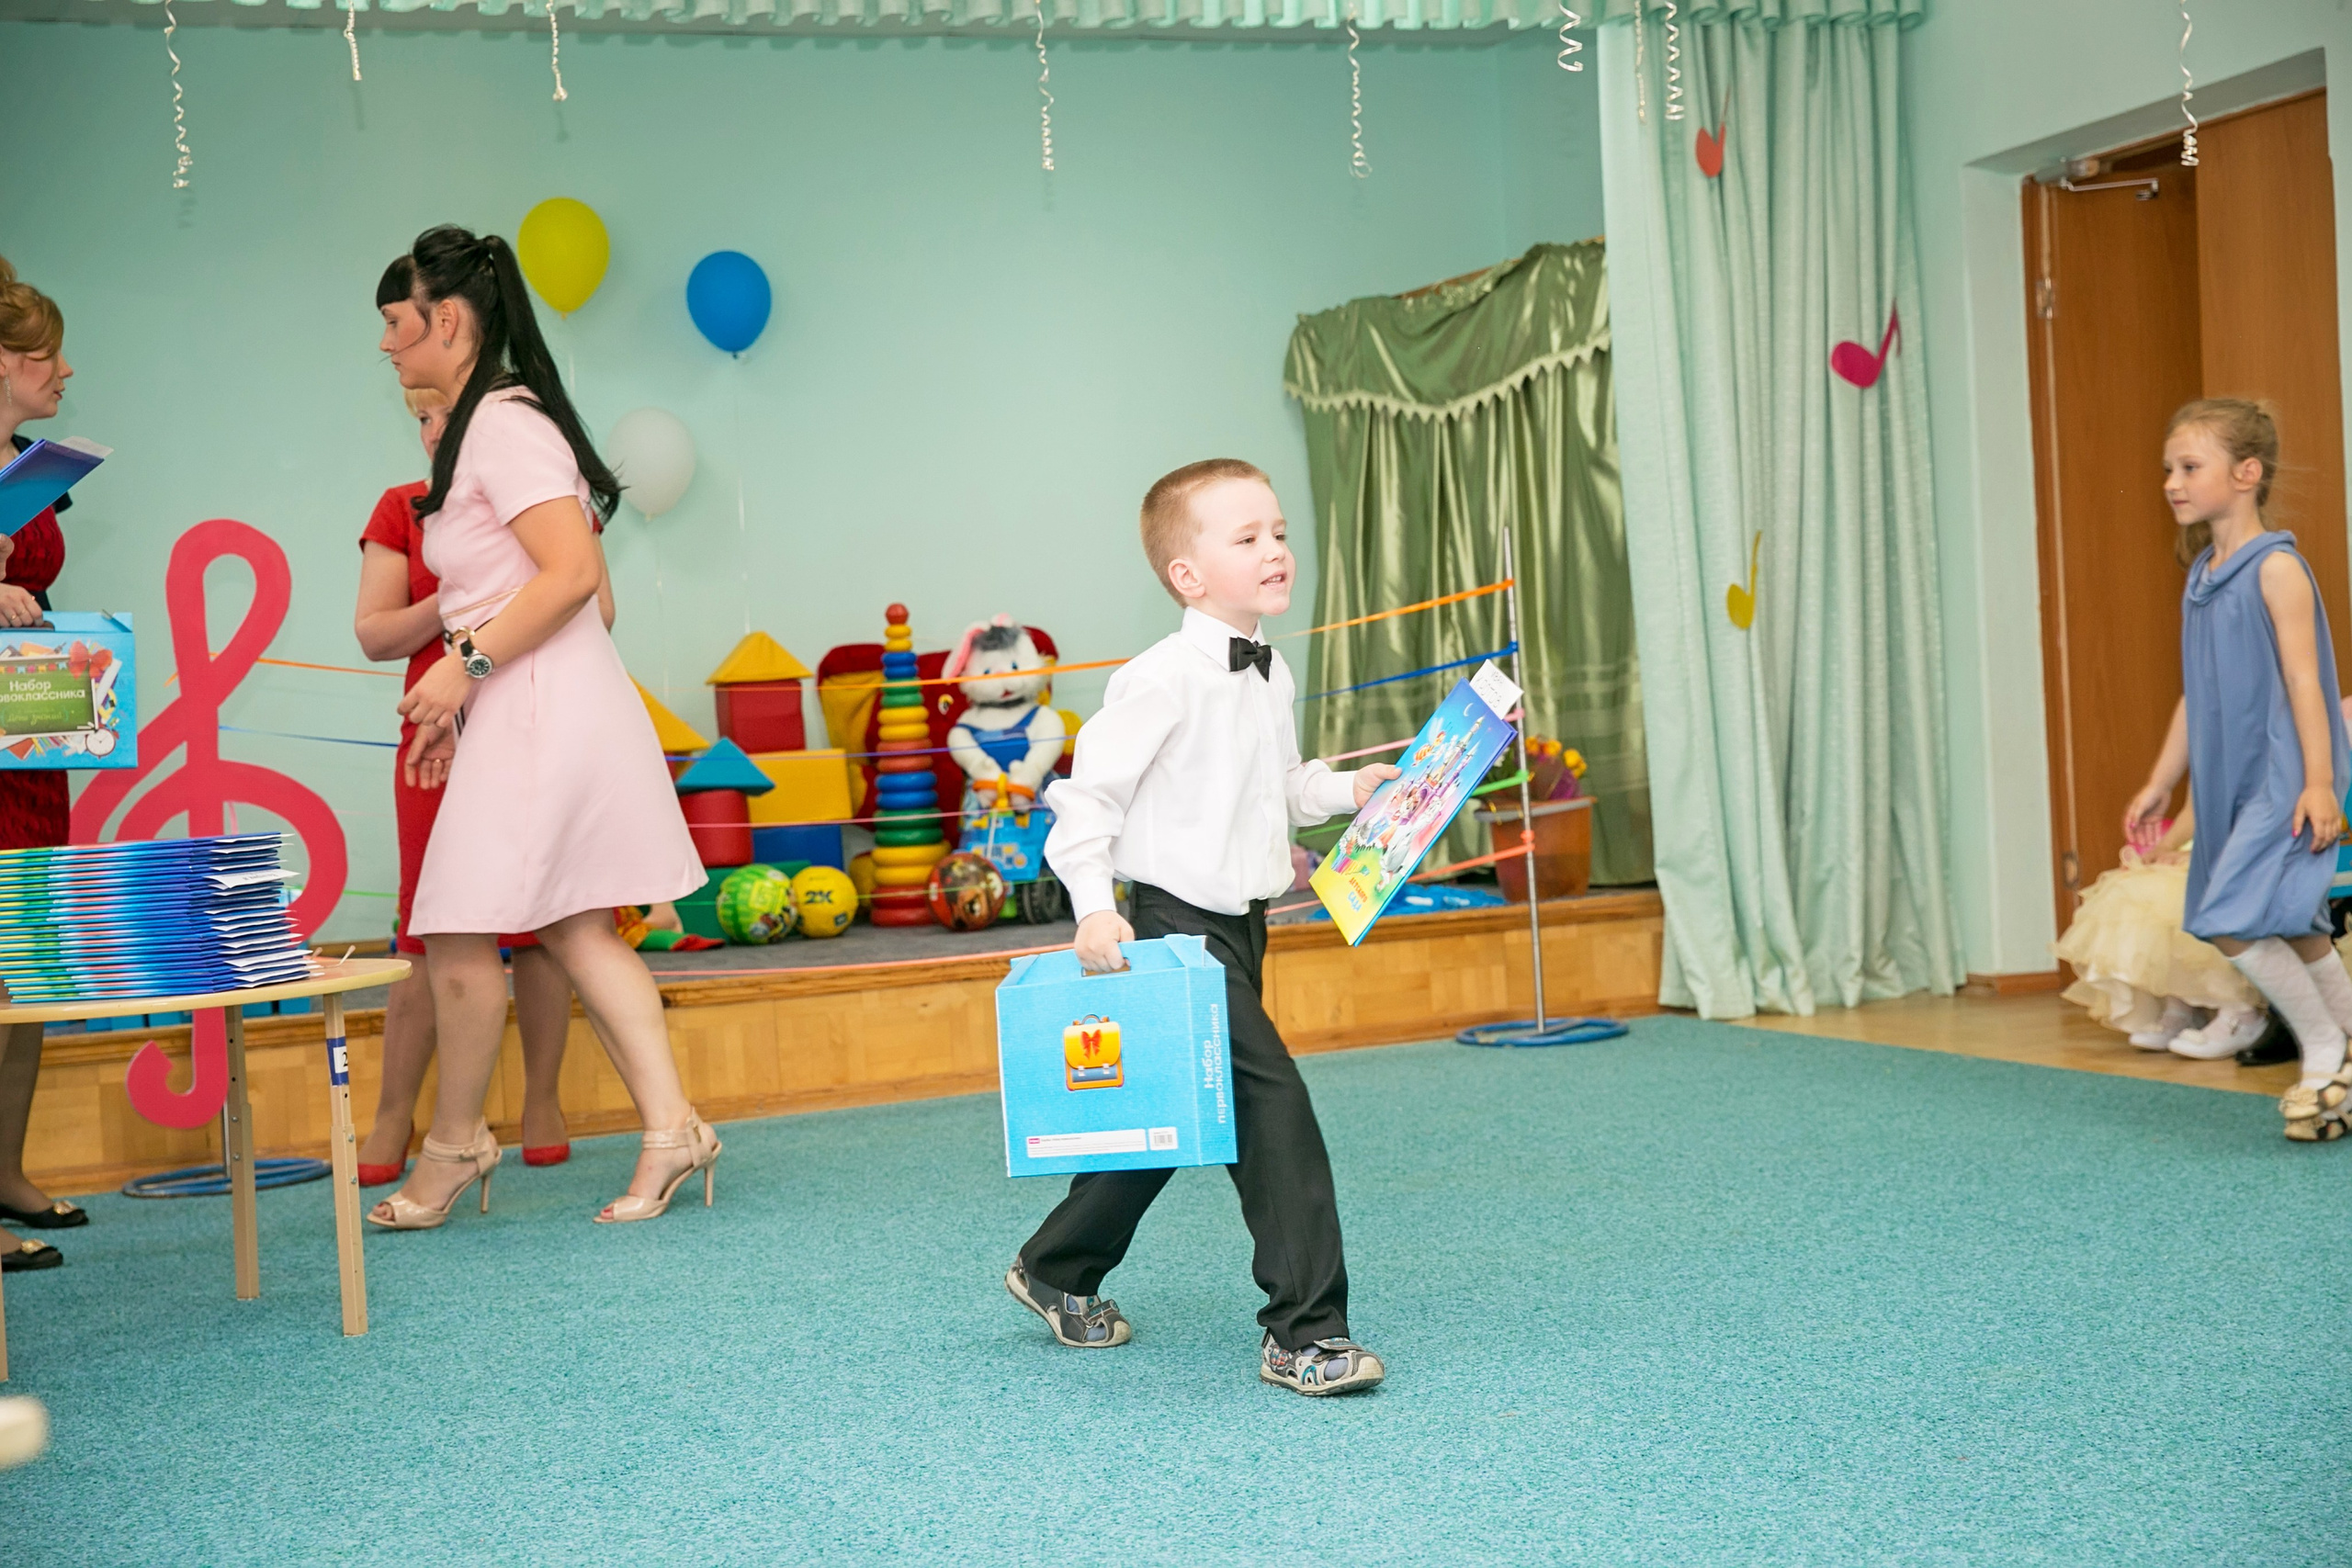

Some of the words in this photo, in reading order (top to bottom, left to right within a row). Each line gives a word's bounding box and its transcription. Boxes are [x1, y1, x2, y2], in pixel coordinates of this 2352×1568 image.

[9, 679, 51, 694] Набор
[1201, 1040, 1215, 1089] Набор
[1210, 1003, 1227, 1124] первоклассника
